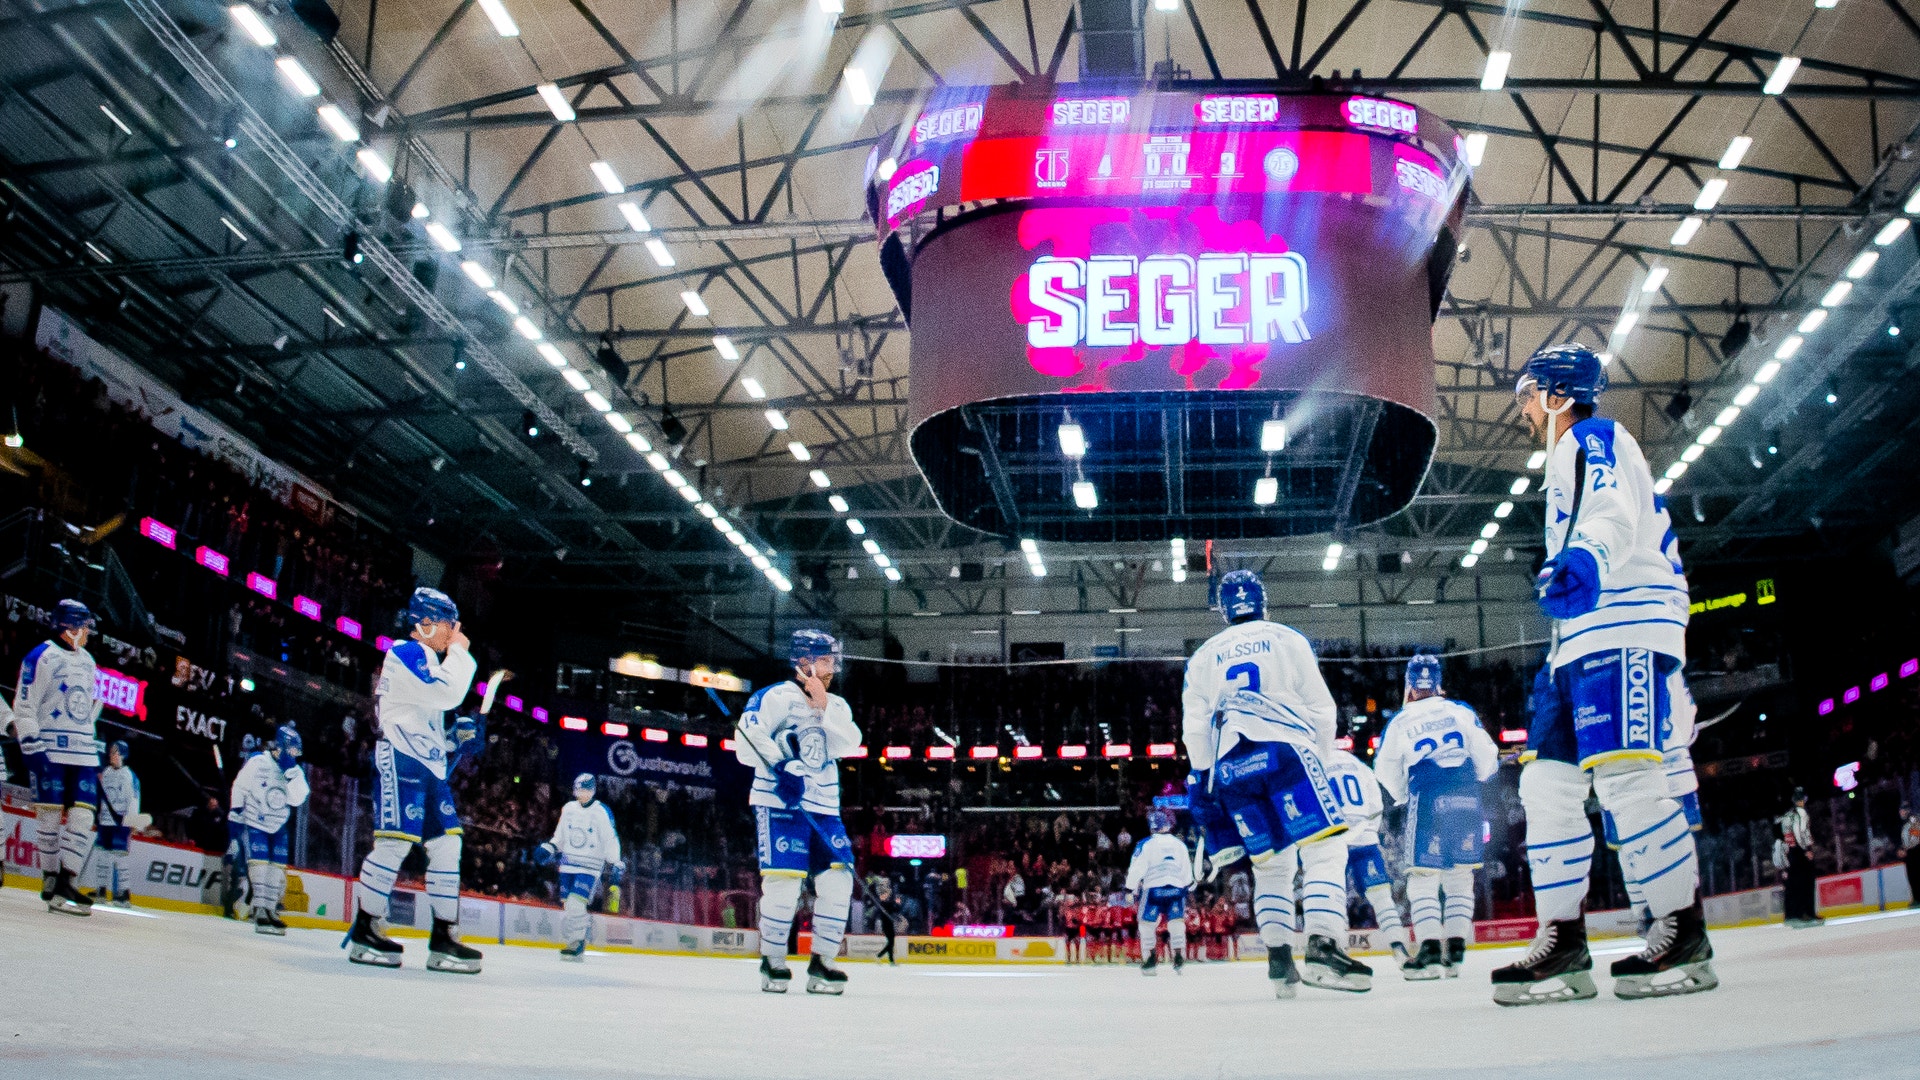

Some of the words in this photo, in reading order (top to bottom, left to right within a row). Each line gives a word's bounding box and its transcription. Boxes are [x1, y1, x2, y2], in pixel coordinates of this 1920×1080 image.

[915, 104, 983, 143] SEGER
[1053, 98, 1130, 125] SEGER
[1201, 97, 1279, 123] SEGER
[1348, 98, 1418, 133] SEGER
[1220, 152, 1236, 175] 3
[1027, 251, 1312, 348] SEGER
[1216, 640, 1271, 666] NILSSON
[176, 705, 227, 742] EXACT
[1328, 774, 1364, 807] 10
